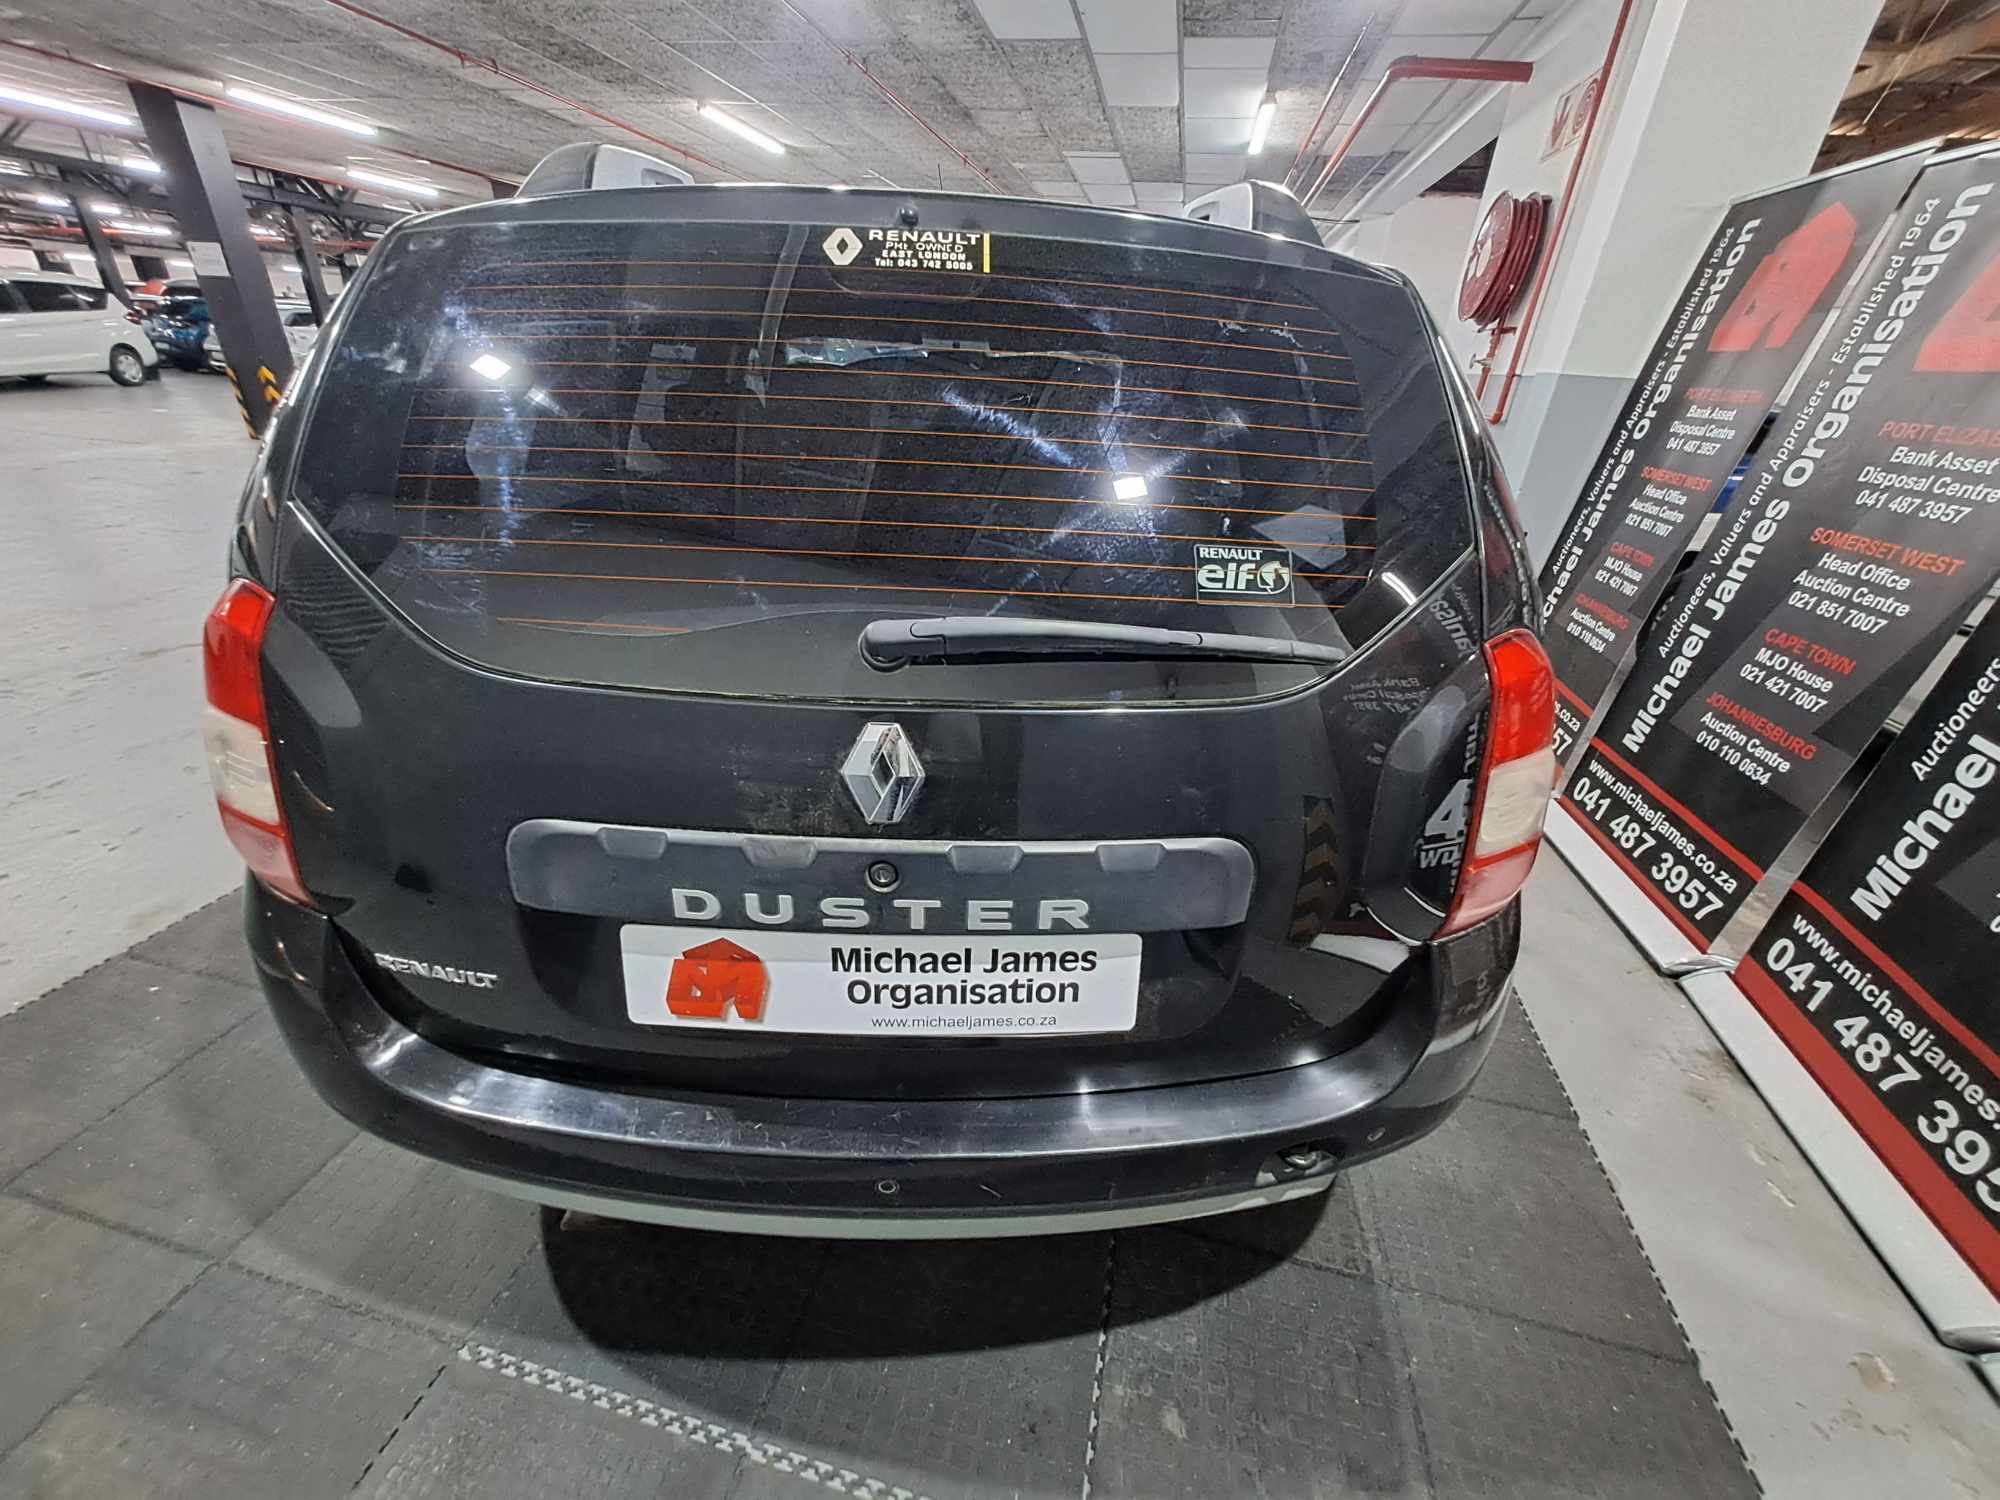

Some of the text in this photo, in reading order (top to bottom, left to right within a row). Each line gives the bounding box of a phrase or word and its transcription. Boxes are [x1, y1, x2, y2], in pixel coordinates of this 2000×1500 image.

[869, 229, 980, 245] RENAULT
[882, 250, 966, 261] EAST LONDON
[1582, 448, 1634, 542] James
[1632, 217, 1762, 440] Organisation
[1587, 456, 1615, 502] Valuers
[1612, 431, 1629, 455] and
[1626, 360, 1667, 430] Appraisers
[1666, 267, 1714, 349] Established
[1709, 226, 1735, 265] 1964
[1658, 571, 1717, 658] Auctioneers,
[1709, 507, 1752, 567] Valuers
[1749, 472, 1773, 506] and
[1769, 379, 1830, 471] Appraisers
[1831, 255, 1905, 364] Established
[1899, 198, 1941, 249] 1964
[1878, 420, 1935, 440] PORT
[1622, 623, 1711, 752] Michael
[1705, 498, 1790, 621] James
[1782, 182, 1995, 488] Organisation
[1889, 446, 2000, 475] Bank Asset
[1855, 490, 1973, 524] 041 487 3957
[1858, 466, 2000, 503] Disposal Centre
[1200, 547, 1263, 560] RENAULT
[1809, 527, 1966, 577] SOMERSET WEST
[1817, 552, 1911, 591] Head Office
[1198, 562, 1256, 589] elf
[1793, 569, 1911, 617] Auction Centre
[1787, 591, 1889, 634] 021 851 7007
[1754, 647, 1834, 693] MJO House
[1765, 628, 1857, 676] CAPE TOWN
[1739, 663, 1828, 713] 021 421 7007
[1700, 711, 1792, 773] Auction Centre
[1706, 691, 1816, 760] JOHANNESBURG
[1695, 730, 1773, 786] 010 110 0634
[1573, 777, 1725, 921] 041 487 3957
[1587, 759, 1738, 894] www.michaeljames.co.za
[1850, 734, 2000, 921] Michael
[672, 888, 1089, 931] DUSTER
[374, 952, 498, 988] RENAULT
[830, 947, 1098, 973] Michael James
[847, 978, 1079, 1009] Organisation
[1766, 937, 1834, 1012] 041
[1833, 1013, 1922, 1093] 487
[871, 1014, 1057, 1030] www.michaeljames.co.za
